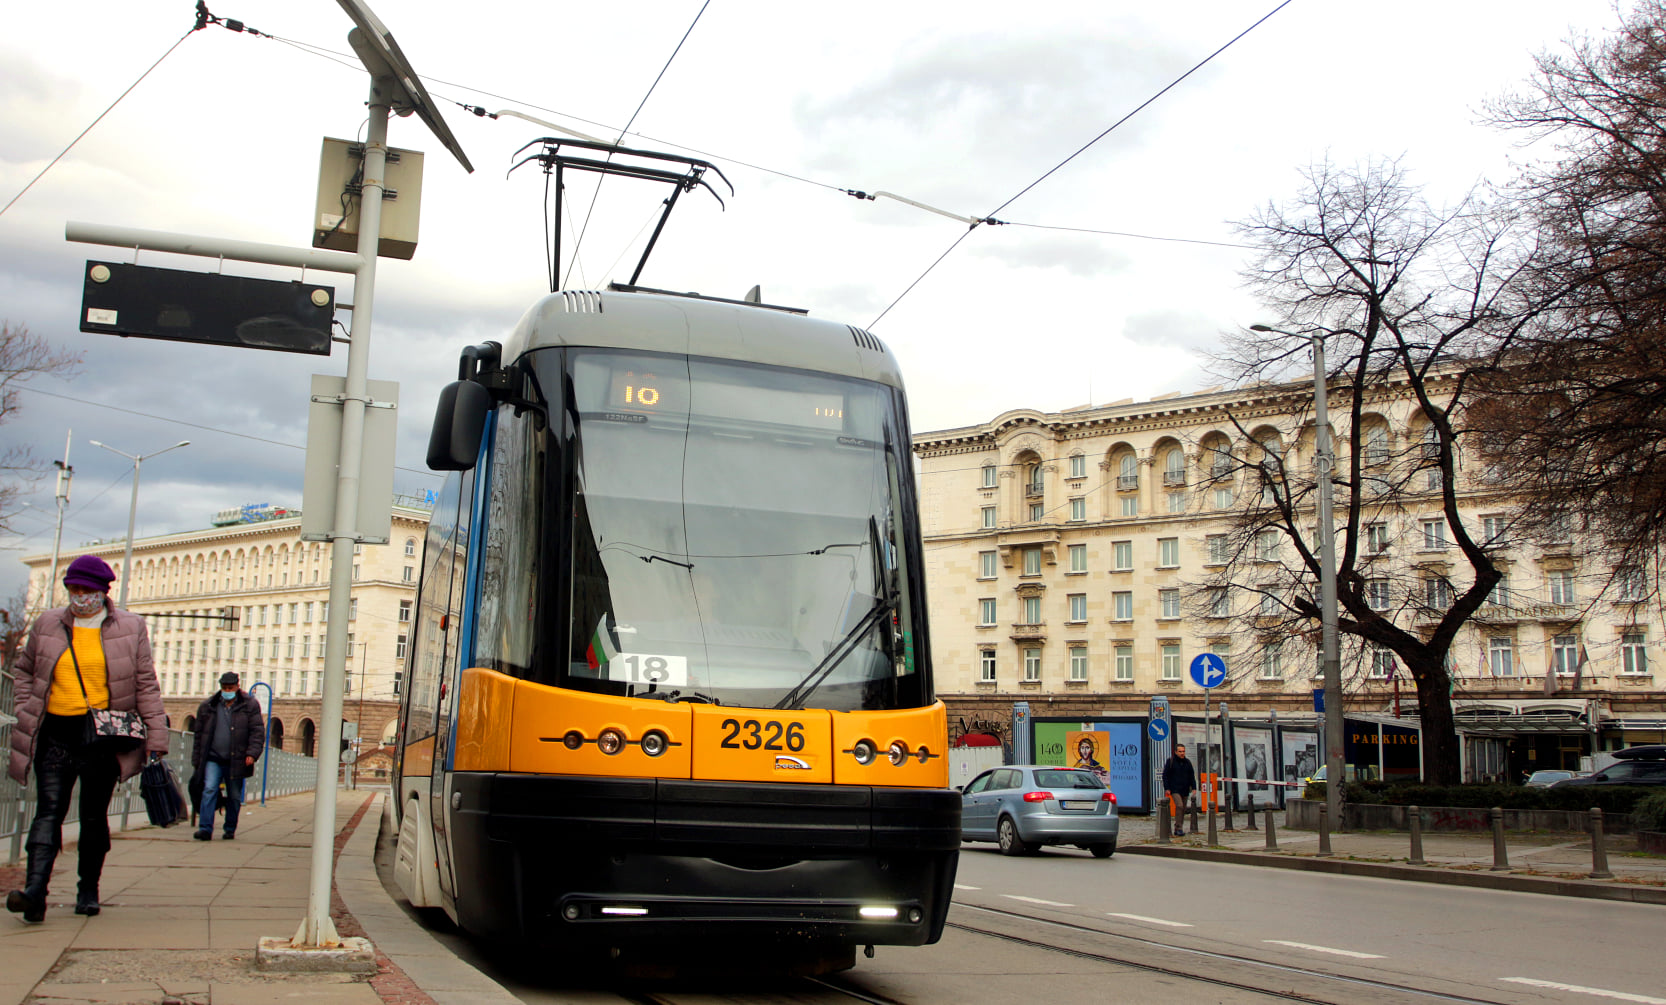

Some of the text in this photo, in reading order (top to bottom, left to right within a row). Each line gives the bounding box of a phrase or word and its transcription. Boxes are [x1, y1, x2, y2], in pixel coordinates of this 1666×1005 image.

[624, 655, 670, 683] 18
[720, 719, 805, 752] 2326
[1352, 733, 1418, 745] PARKING
[1041, 742, 1064, 755] 140
[1114, 744, 1138, 757] 140
